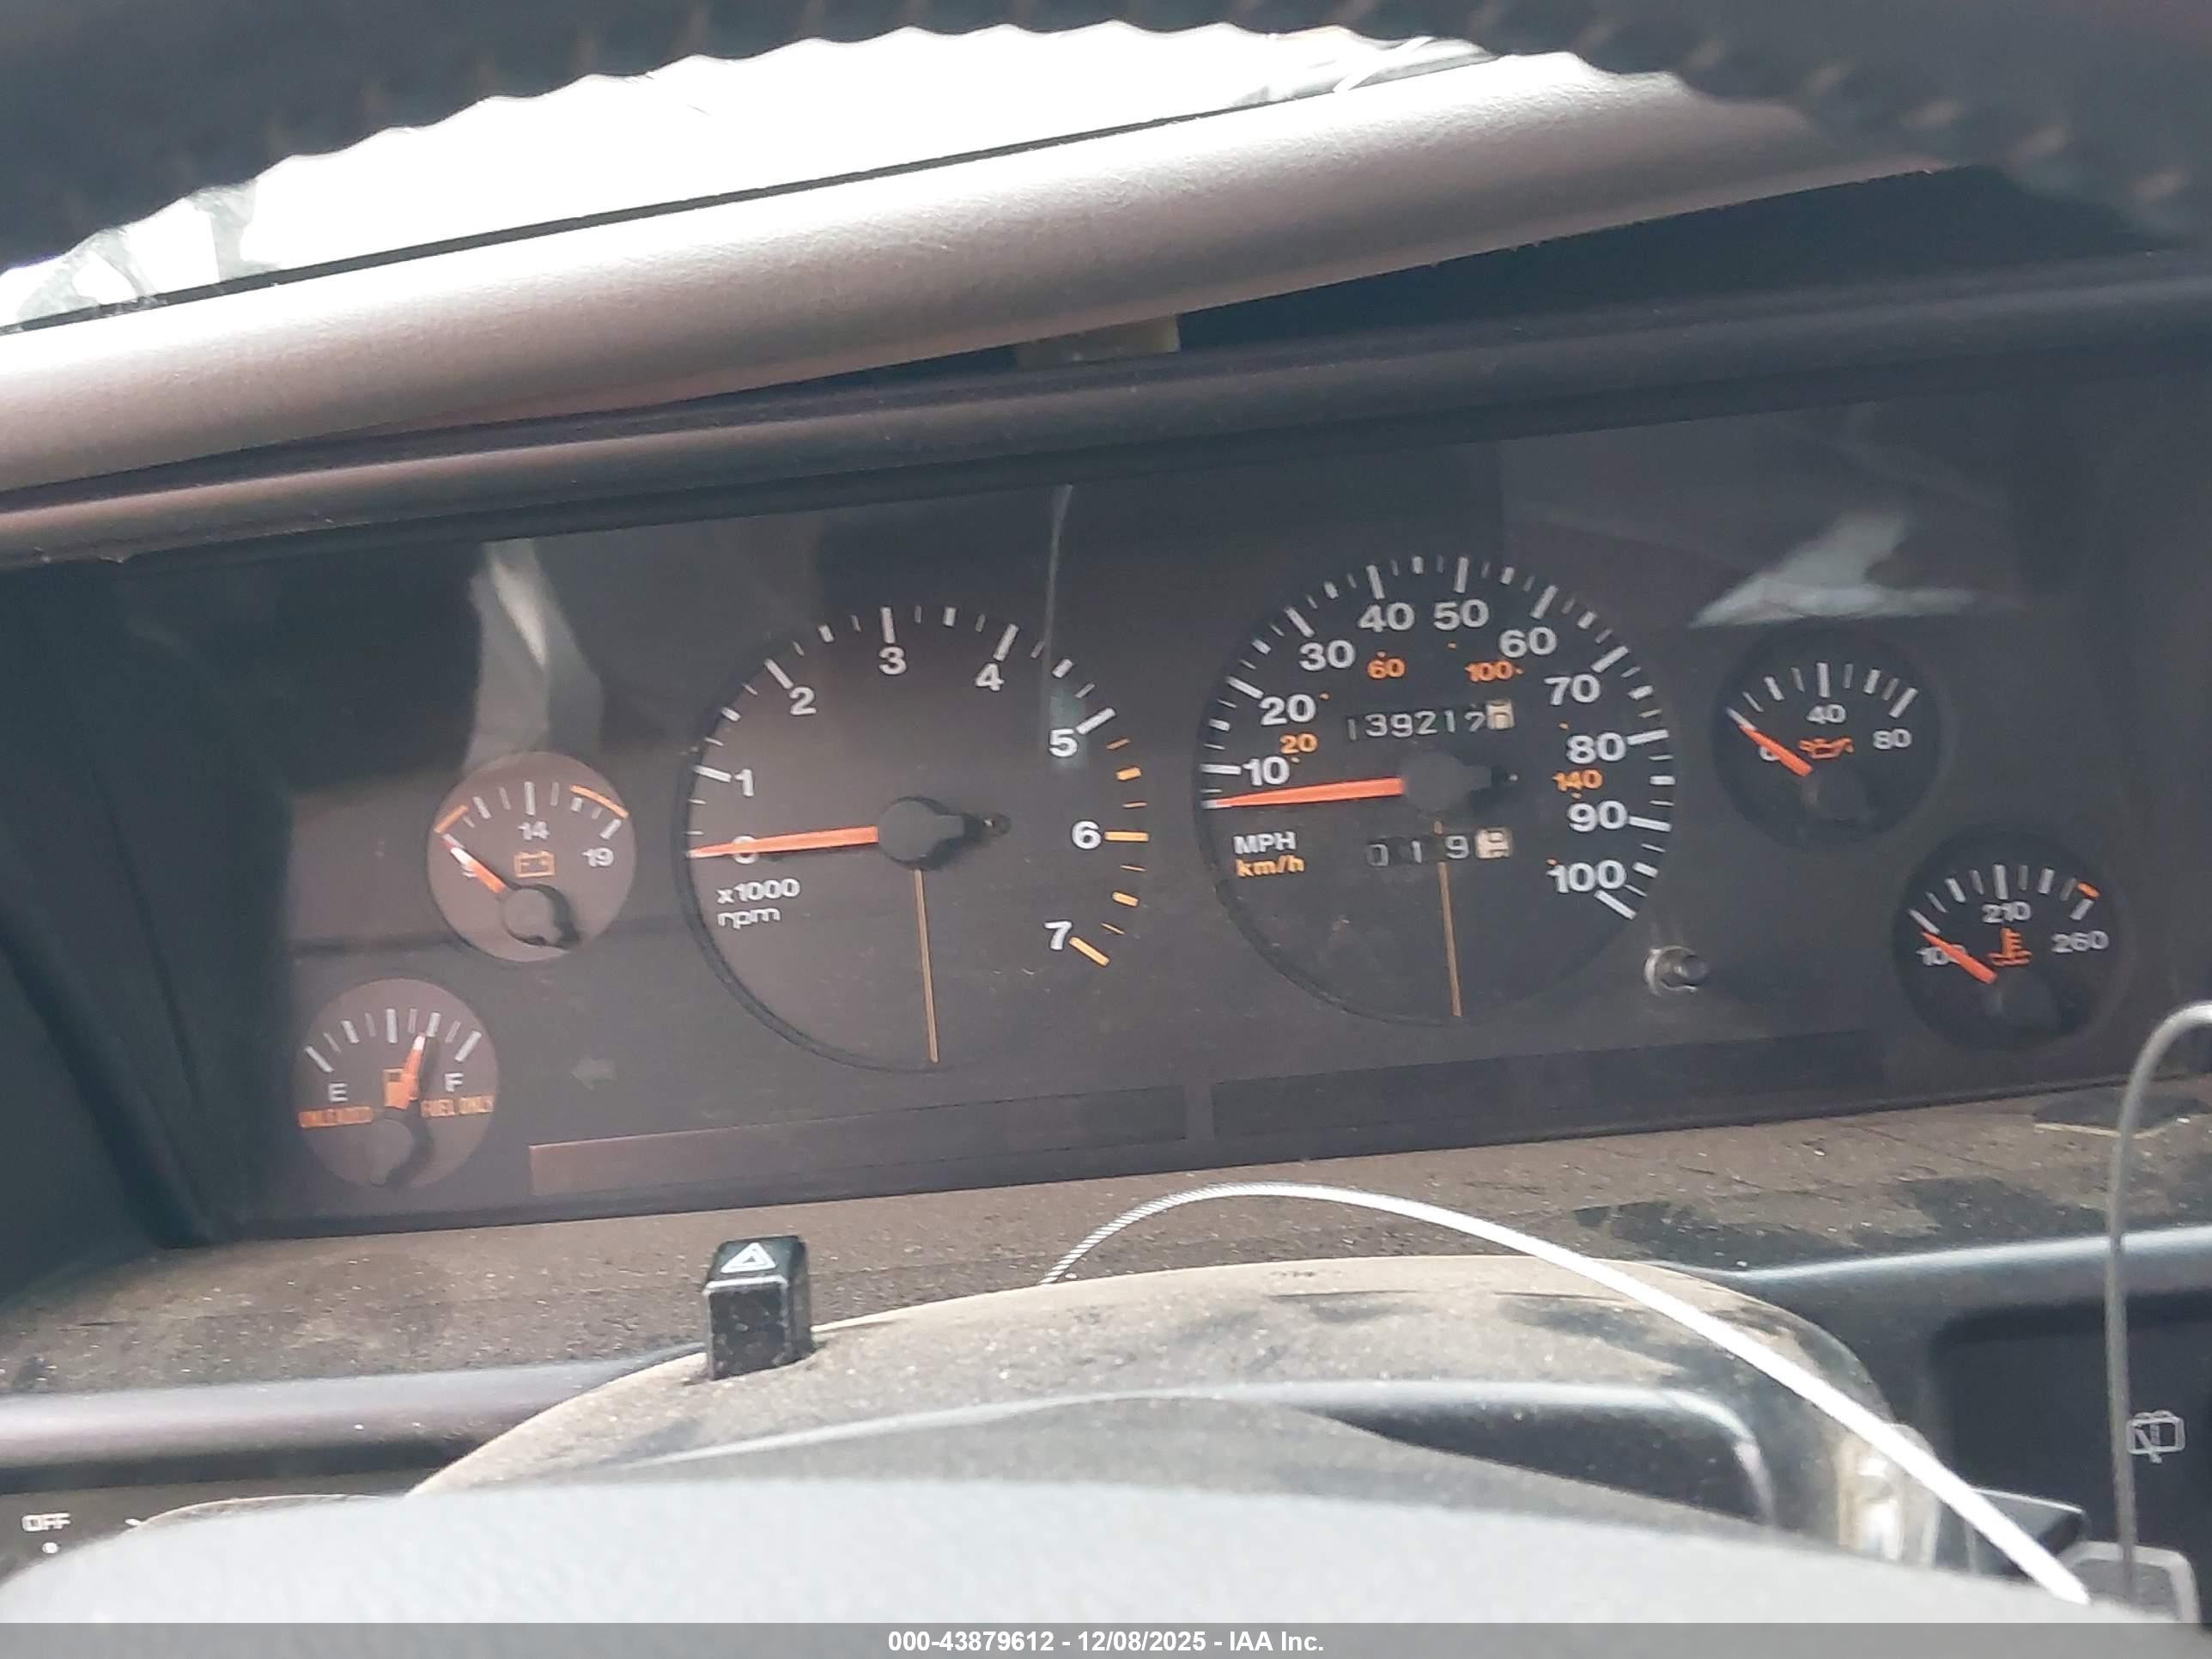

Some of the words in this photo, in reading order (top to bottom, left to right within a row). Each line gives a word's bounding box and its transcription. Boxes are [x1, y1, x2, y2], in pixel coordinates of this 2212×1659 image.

[1358, 602, 1415, 632] 40
[1433, 599, 1489, 630] 50
[1299, 640, 1356, 671] 30
[1498, 627, 1557, 658] 60
[878, 647, 907, 675] 3
[1367, 658, 1406, 679] 60
[1465, 660, 1514, 682] 100
[975, 663, 1005, 691] 4
[1544, 674, 1601, 706] 70
[789, 687, 817, 715] 2
[1260, 695, 1316, 726] 20
[1805, 703, 1846, 725] 40
[1049, 729, 1078, 757] 5
[1279, 733, 1318, 755] 20
[1565, 732, 1627, 763] 80
[1873, 728, 1912, 750] 80
[735, 769, 754, 797] 1
[1243, 757, 1290, 786] 10
[1551, 769, 1603, 792] 140
[1567, 801, 1627, 831] 90
[517, 821, 550, 841] 14
[1071, 821, 1102, 849] 6
[1233, 830, 1296, 854] MPH
[581, 848, 614, 867] 19
[1235, 855, 1305, 879] km/h
[717, 878, 800, 904] x1000
[1548, 863, 1627, 893] 100
[717, 908, 781, 929] rpm
[1982, 901, 2032, 924] 210
[1044, 921, 1072, 950] 7
[2051, 930, 2110, 953] 260
[328, 1082, 348, 1103] E
[445, 1073, 464, 1092] F
[21, 1512, 71, 1533] OFF
